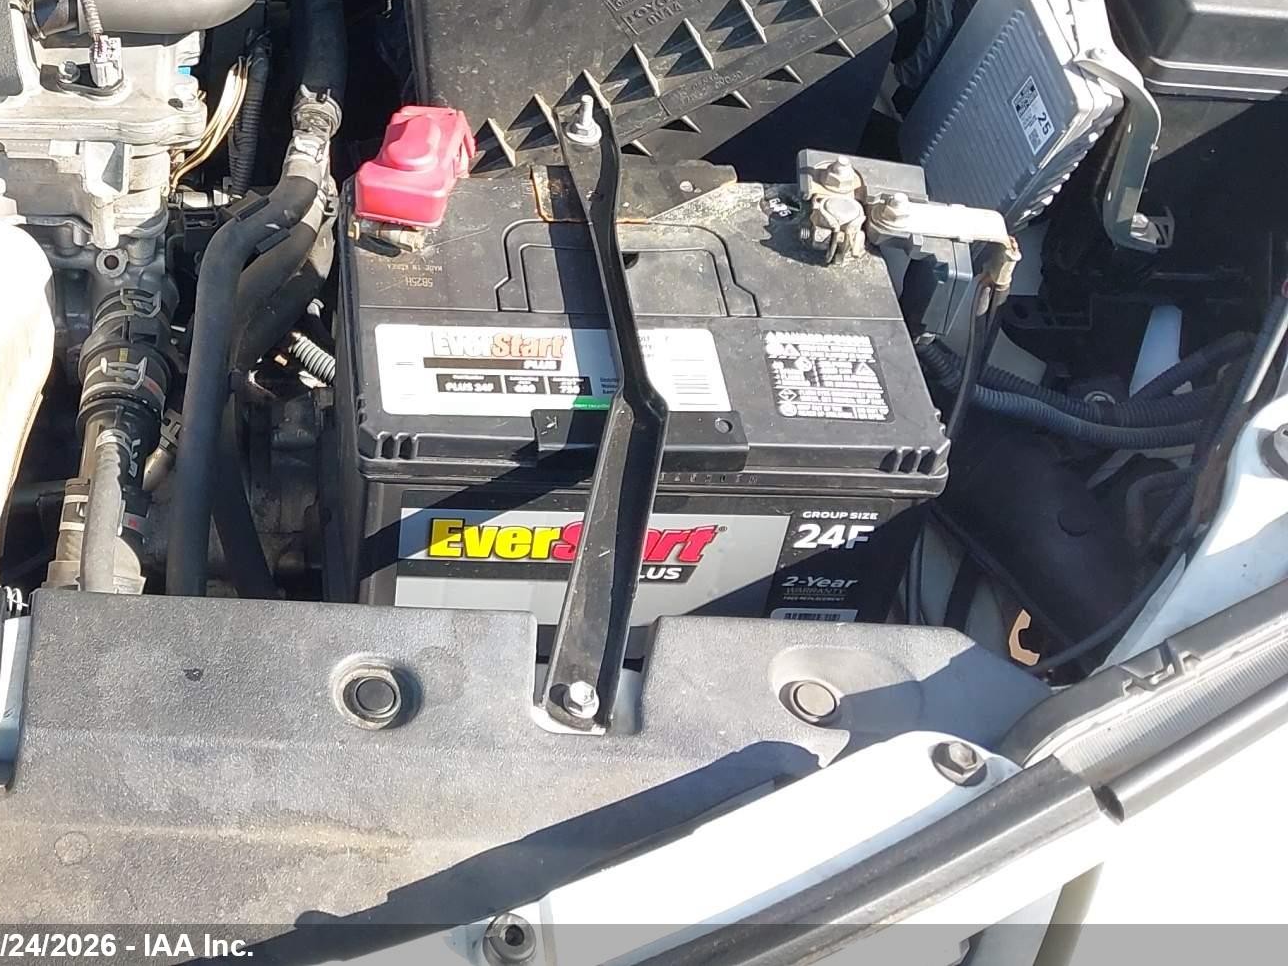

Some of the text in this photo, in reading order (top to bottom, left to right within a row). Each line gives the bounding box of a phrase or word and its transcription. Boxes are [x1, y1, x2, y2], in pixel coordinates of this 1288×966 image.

[1037, 111, 1052, 135] 25
[431, 330, 565, 358] EverStart
[523, 360, 558, 370] PLUS
[802, 510, 879, 520] GROUP SIZE
[792, 523, 875, 549] 24F
[781, 576, 859, 588] 2-Year
